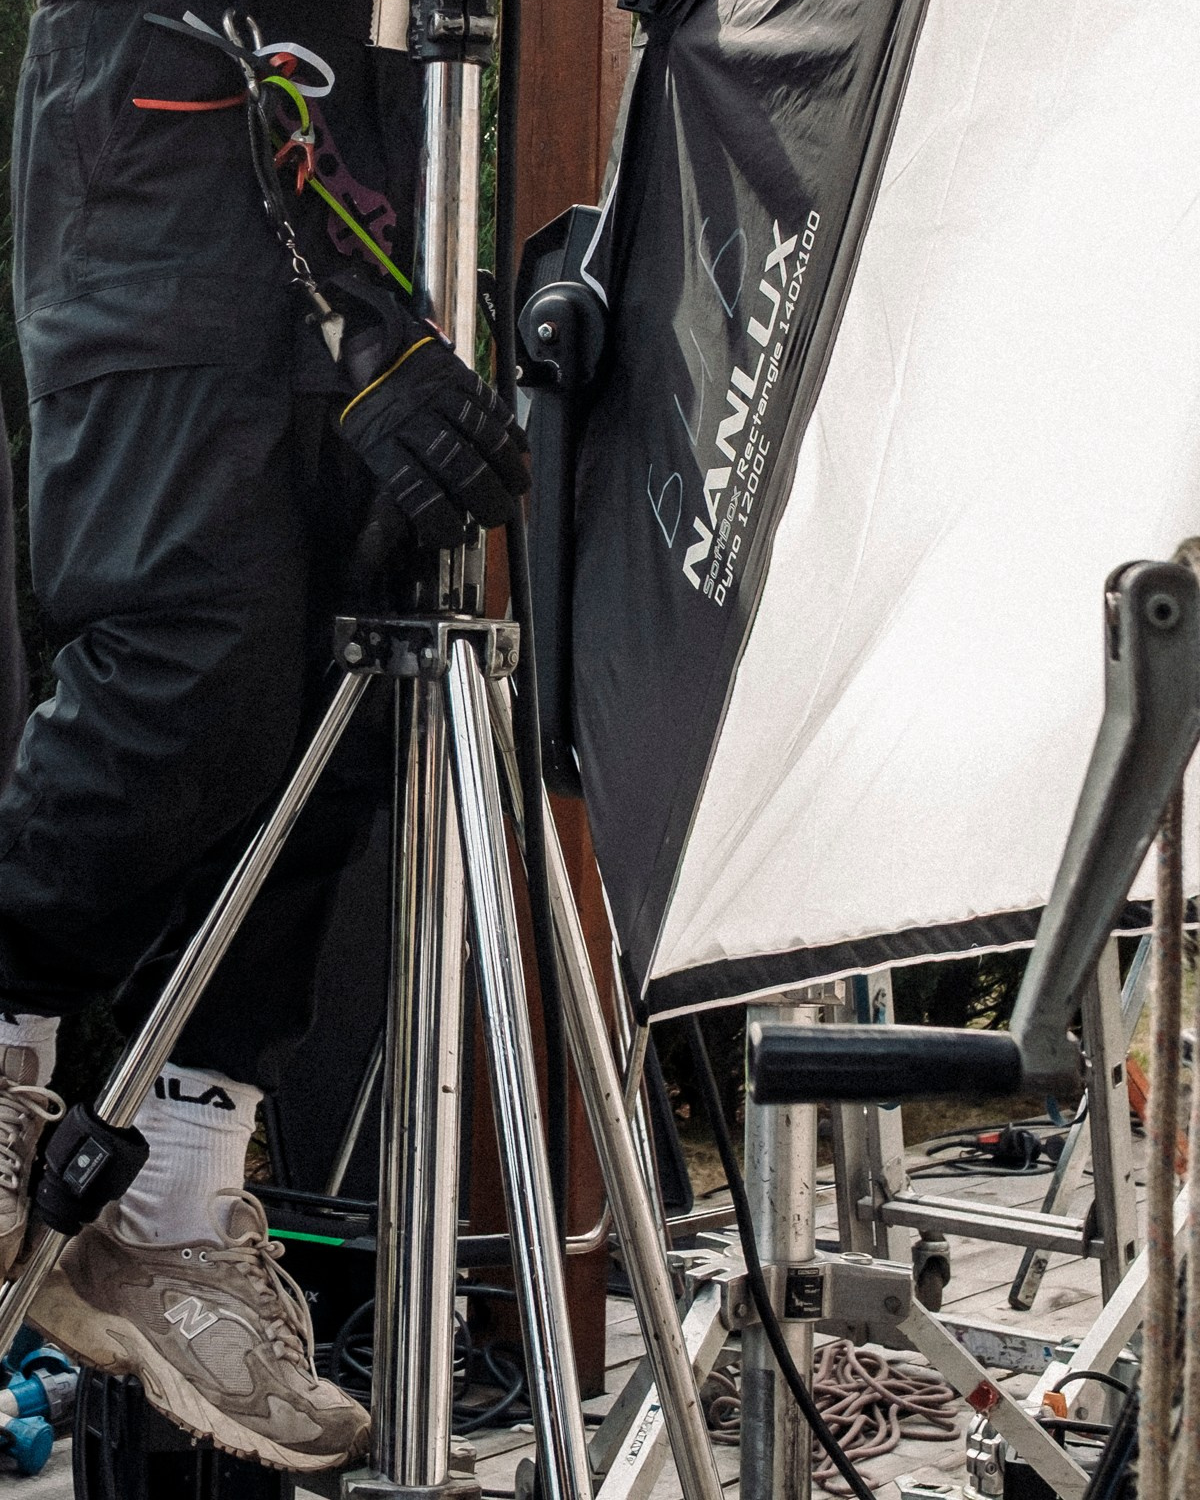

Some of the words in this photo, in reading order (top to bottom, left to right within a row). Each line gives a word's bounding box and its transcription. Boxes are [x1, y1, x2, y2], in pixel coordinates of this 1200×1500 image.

[682, 219, 798, 589] NANLUX
[703, 488, 741, 598] SoftBox
[736, 340, 784, 480] Rectangle
[714, 536, 742, 607] Dyno
[738, 439, 771, 528] 1200C
[154, 1075, 237, 1111] ILA
[164, 1296, 219, 1340] N
